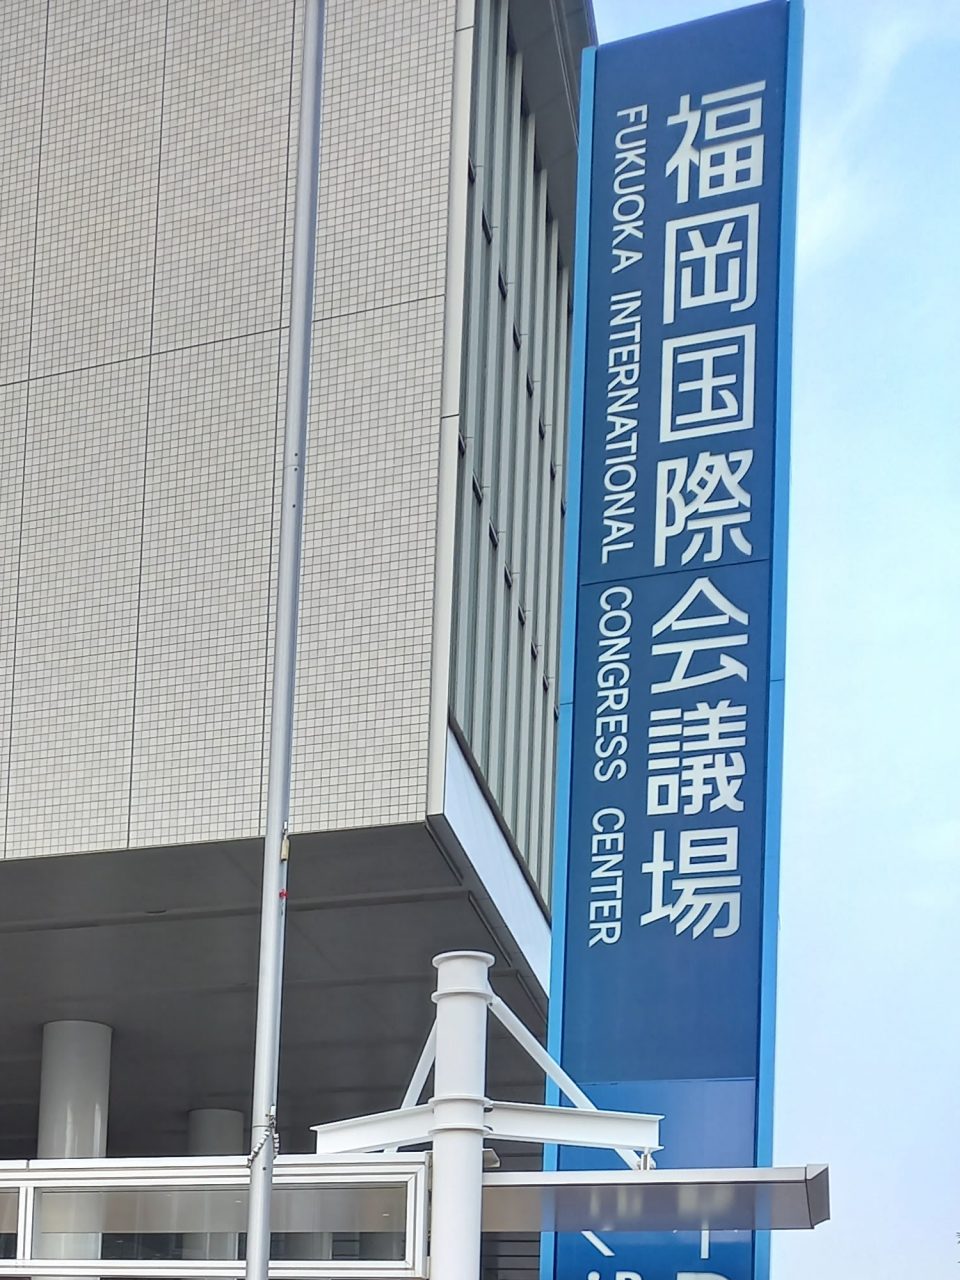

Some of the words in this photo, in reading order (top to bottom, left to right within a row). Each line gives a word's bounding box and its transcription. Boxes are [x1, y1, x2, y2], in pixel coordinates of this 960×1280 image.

[611, 103, 648, 274] FUKUOKA
[601, 290, 642, 564] INTERNATIONAL
[640, 80, 766, 940] 福岡国際会議場
[593, 586, 634, 782] CONGRESS
[588, 807, 625, 947] CENTER
